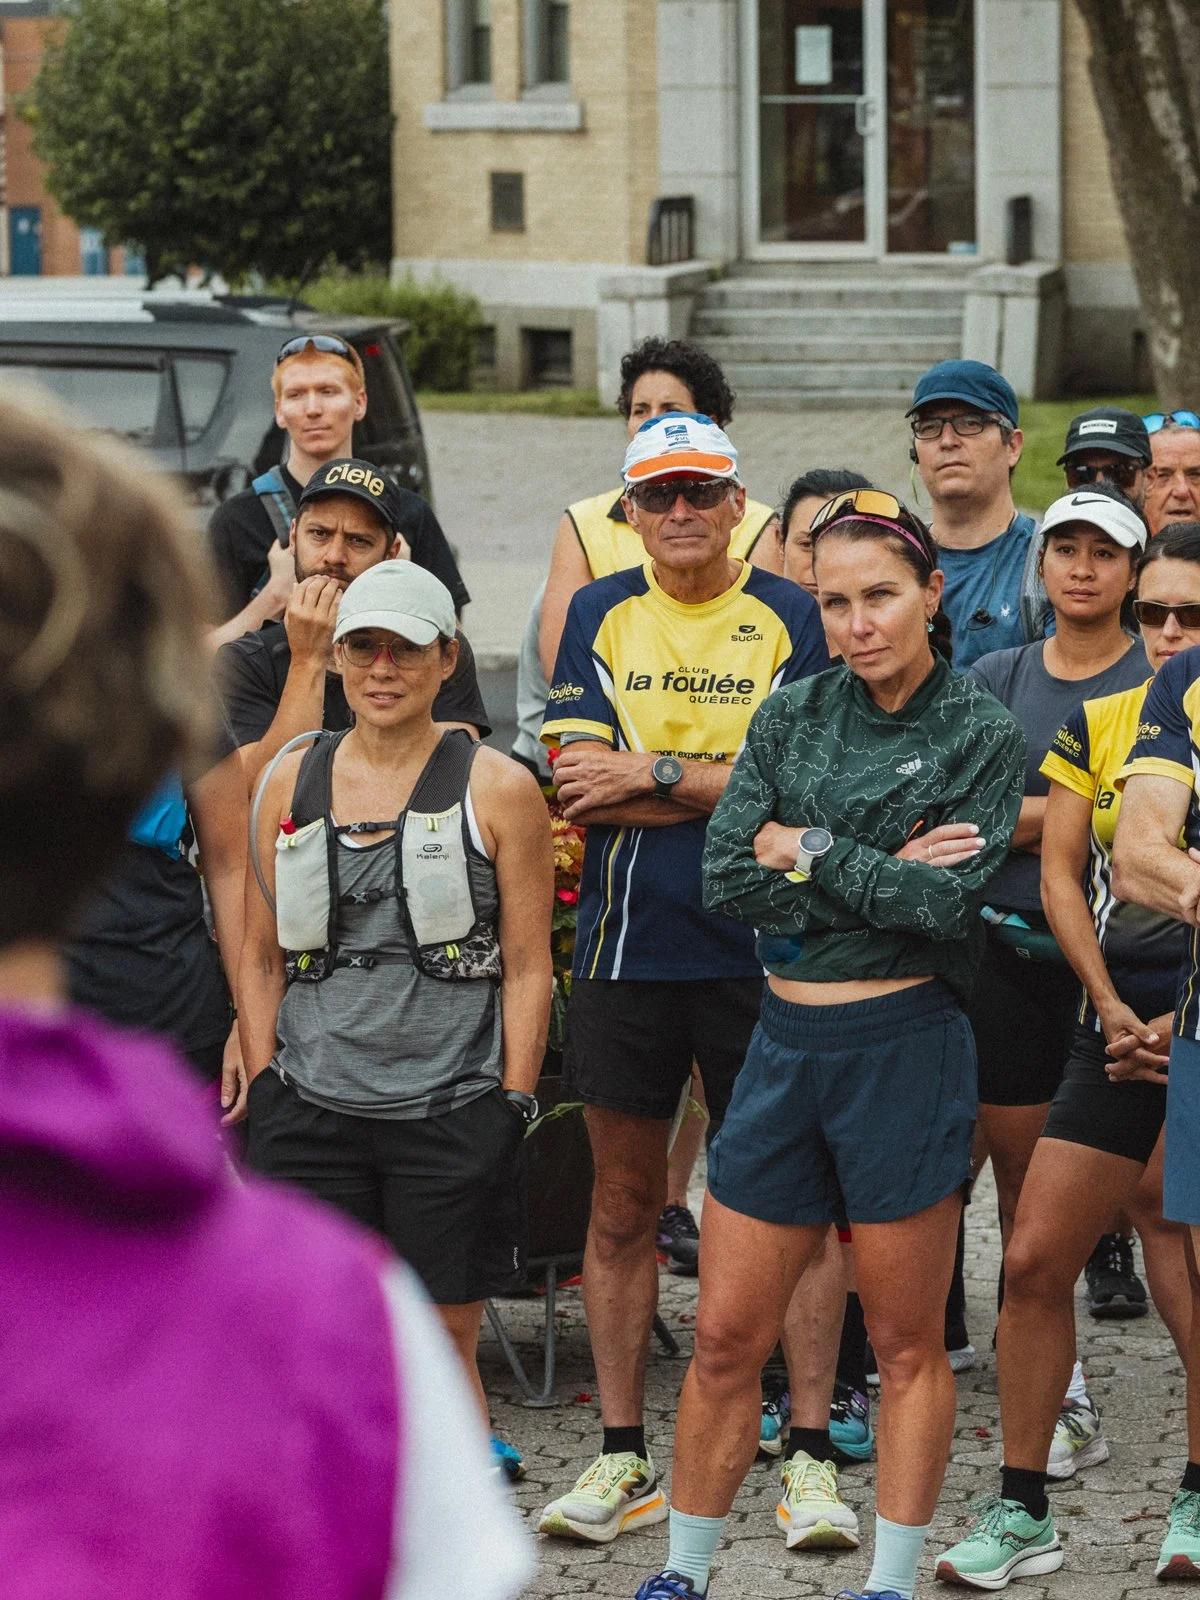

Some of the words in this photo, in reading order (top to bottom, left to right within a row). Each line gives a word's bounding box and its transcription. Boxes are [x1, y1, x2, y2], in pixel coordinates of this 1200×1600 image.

[324, 463, 385, 496] ciele
[678, 666, 710, 675] CLUB
[625, 671, 653, 691] la
[662, 672, 755, 694] foulée
[689, 695, 752, 705] QUÉBEC
